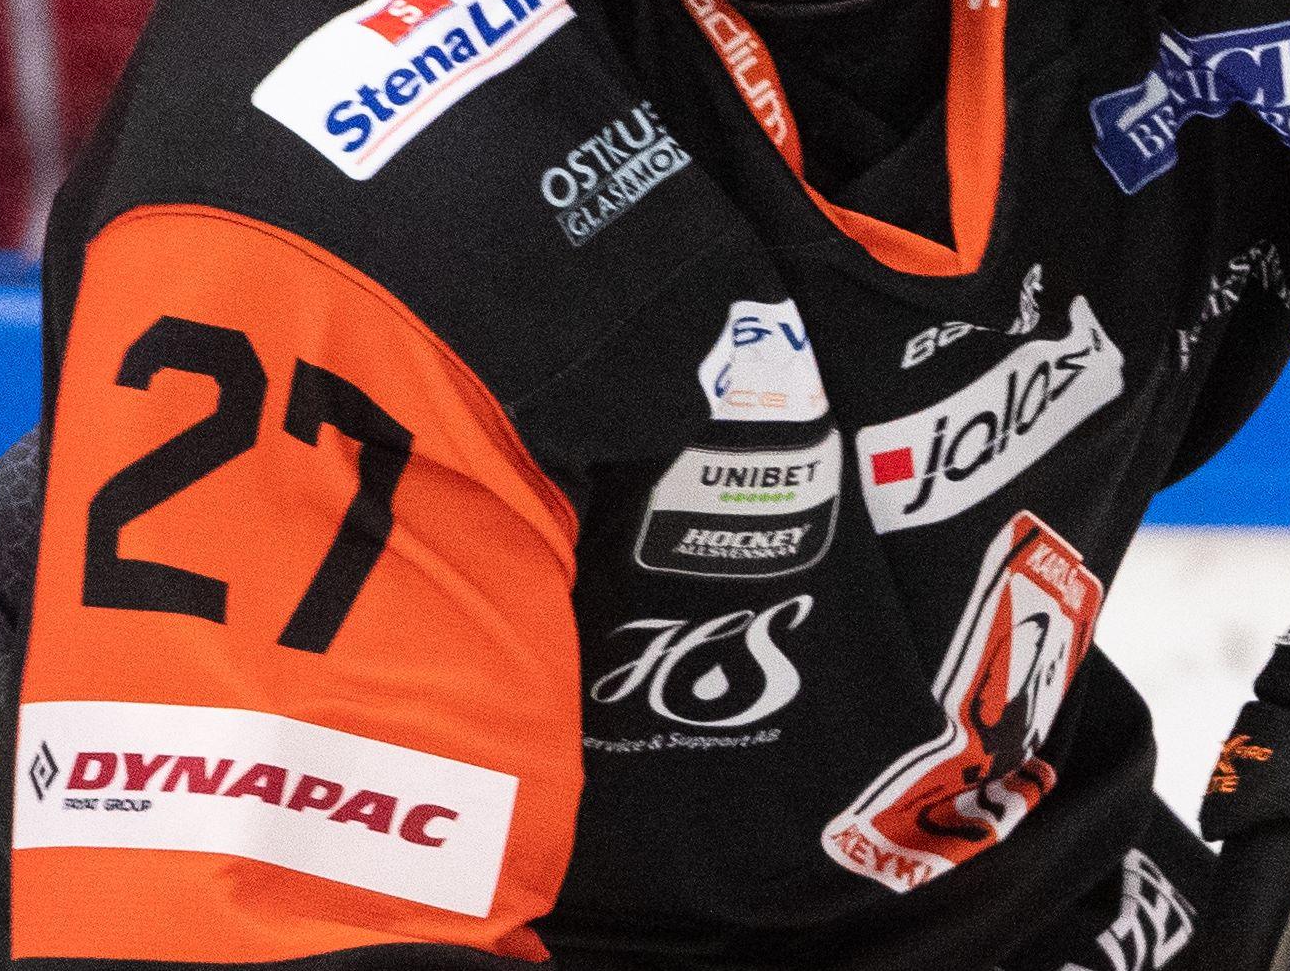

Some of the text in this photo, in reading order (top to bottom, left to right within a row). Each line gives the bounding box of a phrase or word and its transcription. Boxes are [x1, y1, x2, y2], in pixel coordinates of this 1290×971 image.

[325, 27, 480, 153] Stena
[82, 315, 414, 655] 27
[700, 460, 821, 488] UNIBET
[681, 525, 812, 547] HOCKEY
[66, 751, 459, 848] DYNAPAC
